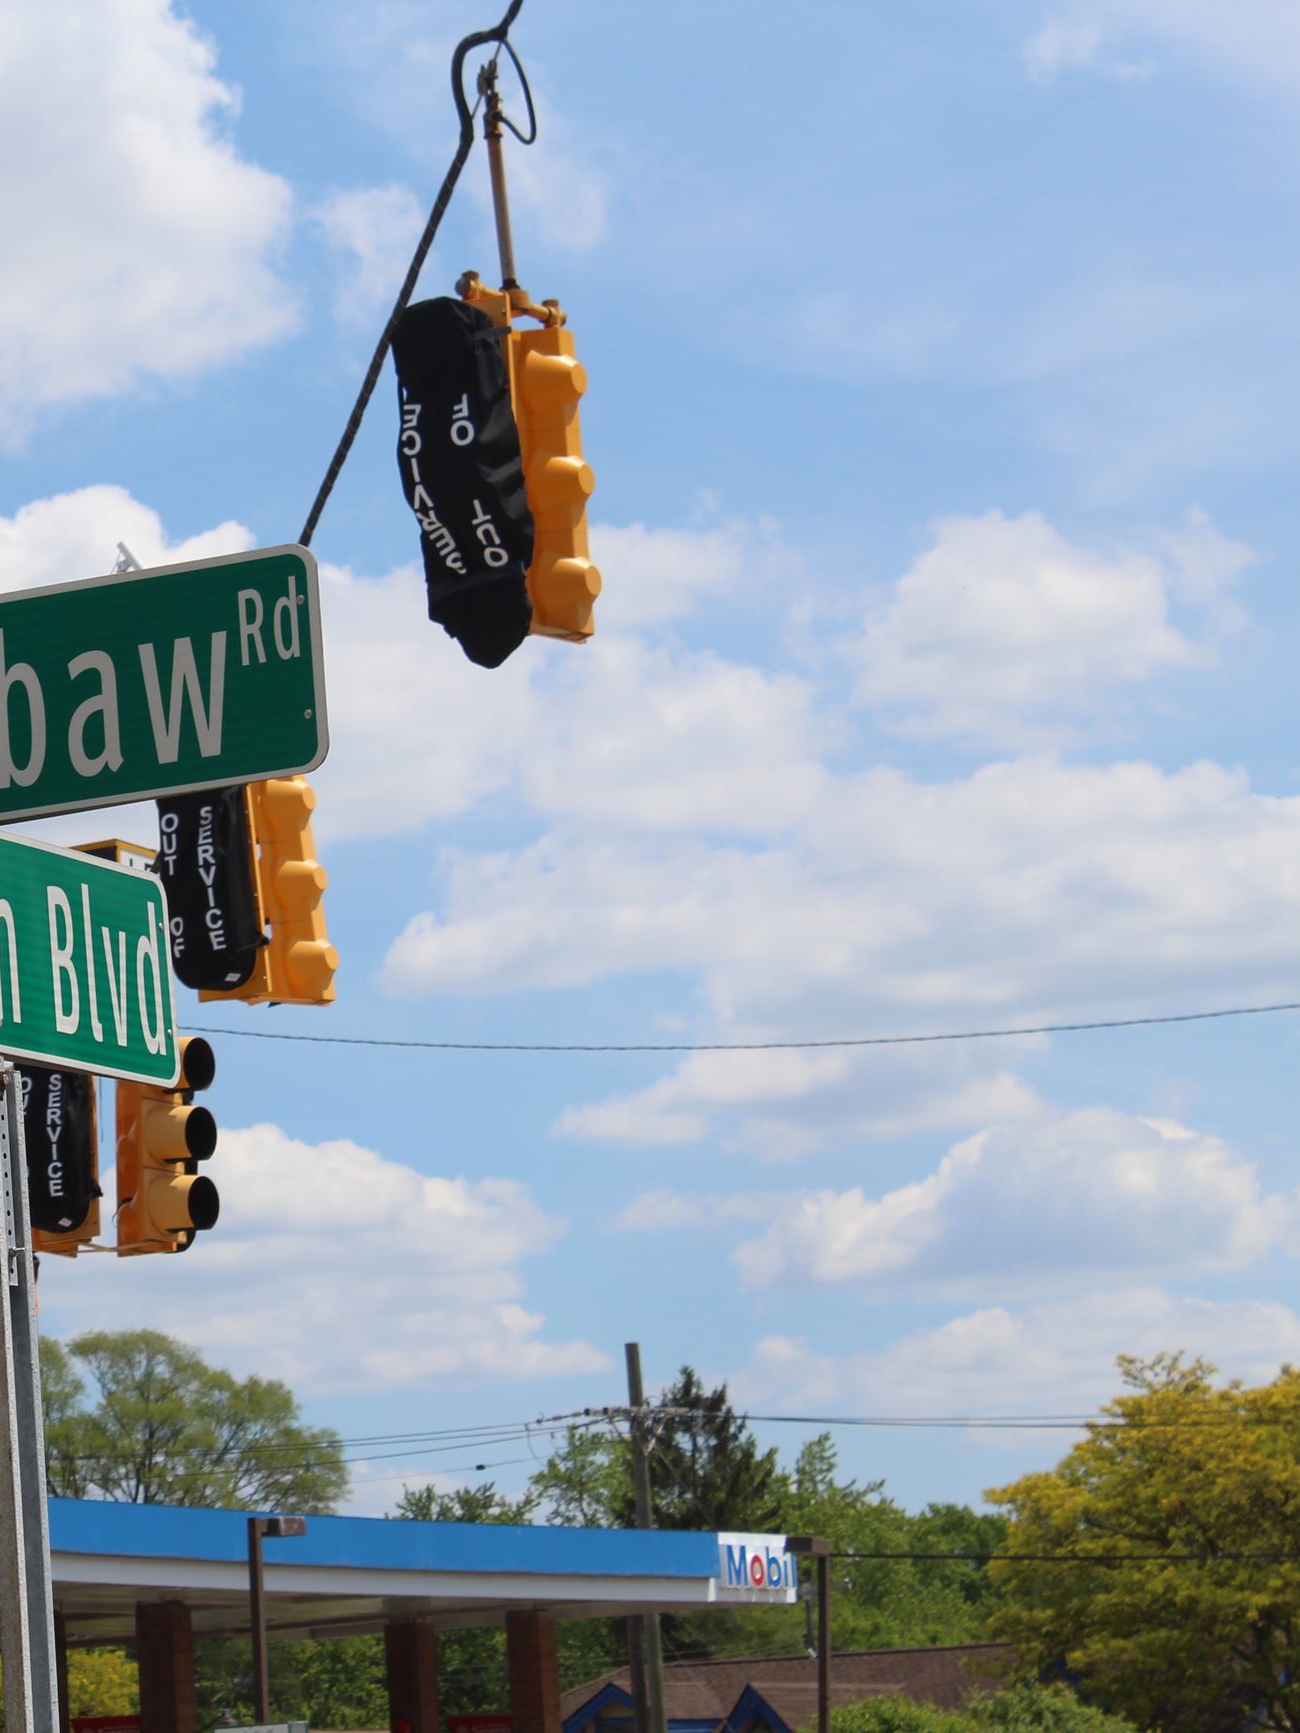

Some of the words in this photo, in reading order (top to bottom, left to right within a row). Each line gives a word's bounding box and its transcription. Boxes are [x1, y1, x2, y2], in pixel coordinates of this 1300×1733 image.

[450, 393, 475, 446] OF
[471, 499, 508, 568] OUT
[237, 575, 304, 667] Rd
[160, 813, 179, 876] OUT
[170, 917, 185, 958] OF
[197, 806, 227, 951] SERVICE
[46, 882, 167, 1056] Blvd
[45, 1073, 64, 1198] SERVICE
